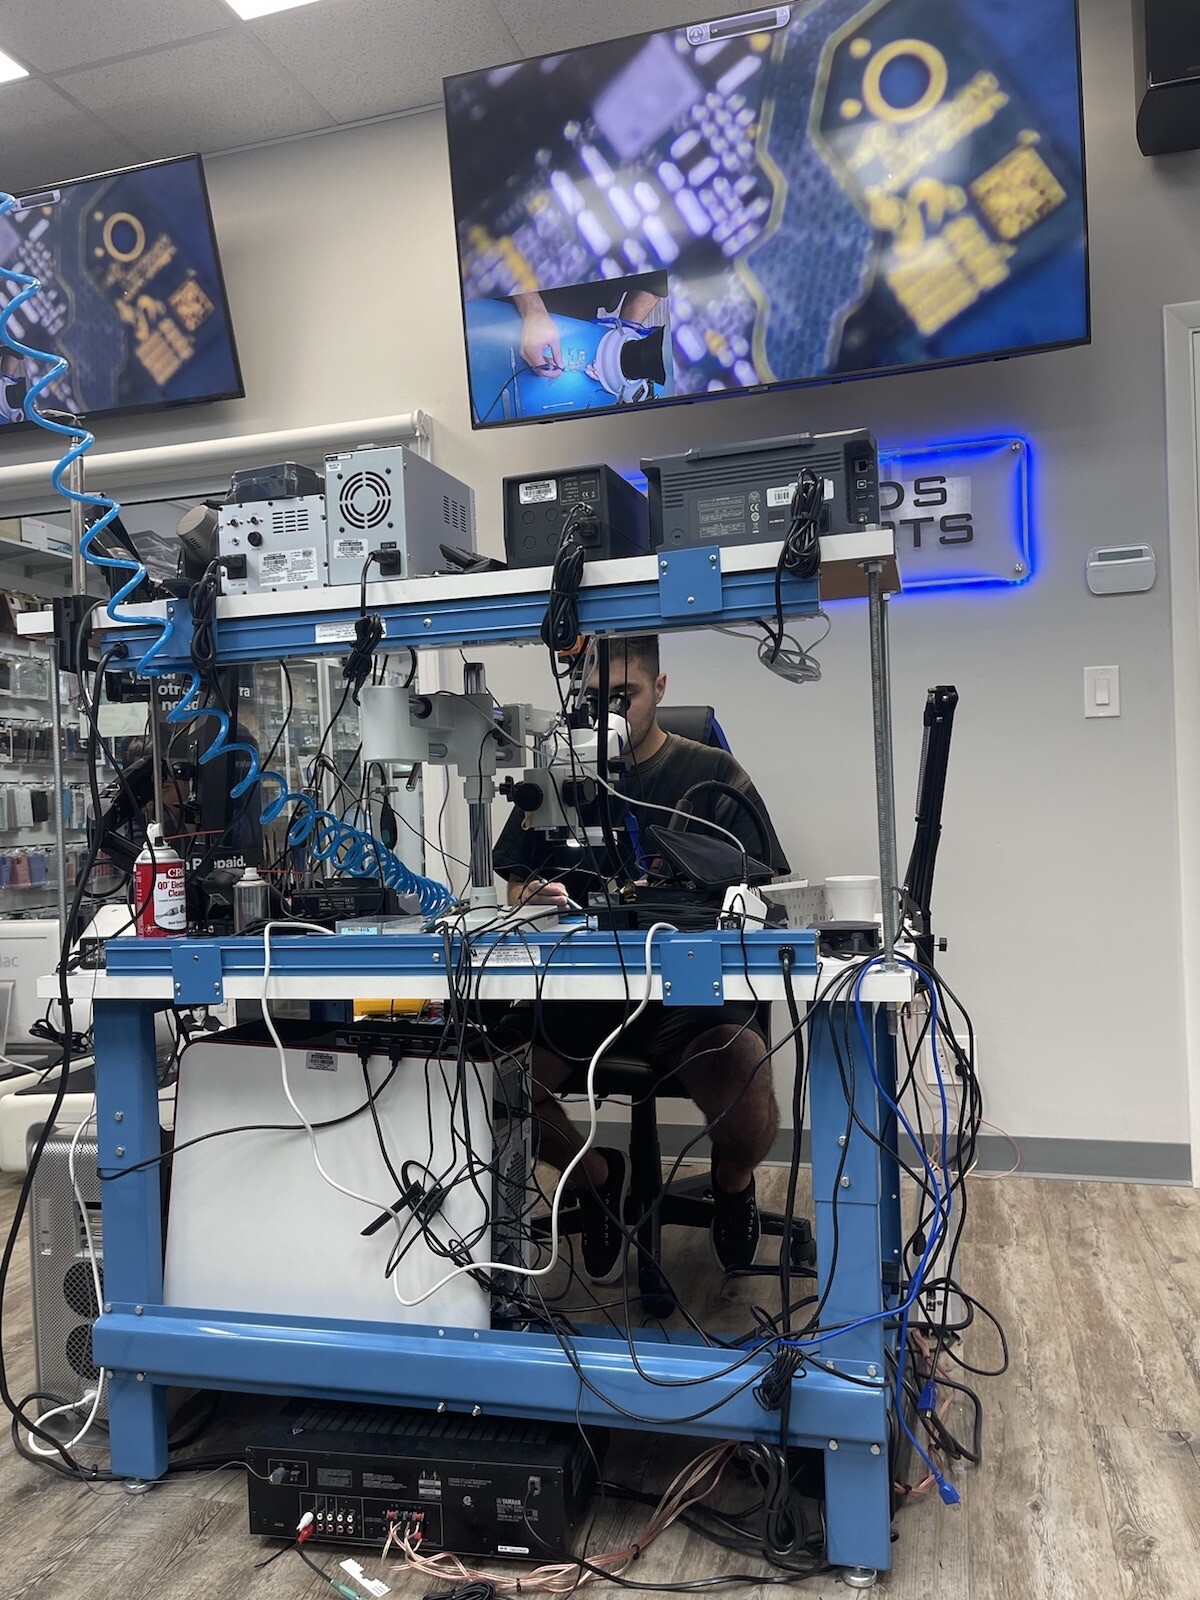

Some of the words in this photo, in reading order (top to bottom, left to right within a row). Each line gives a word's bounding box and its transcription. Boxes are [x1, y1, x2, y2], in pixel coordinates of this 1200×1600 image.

[192, 855, 246, 870] Ppaid.
[167, 868, 184, 878] CR
[0, 953, 18, 967] ac
